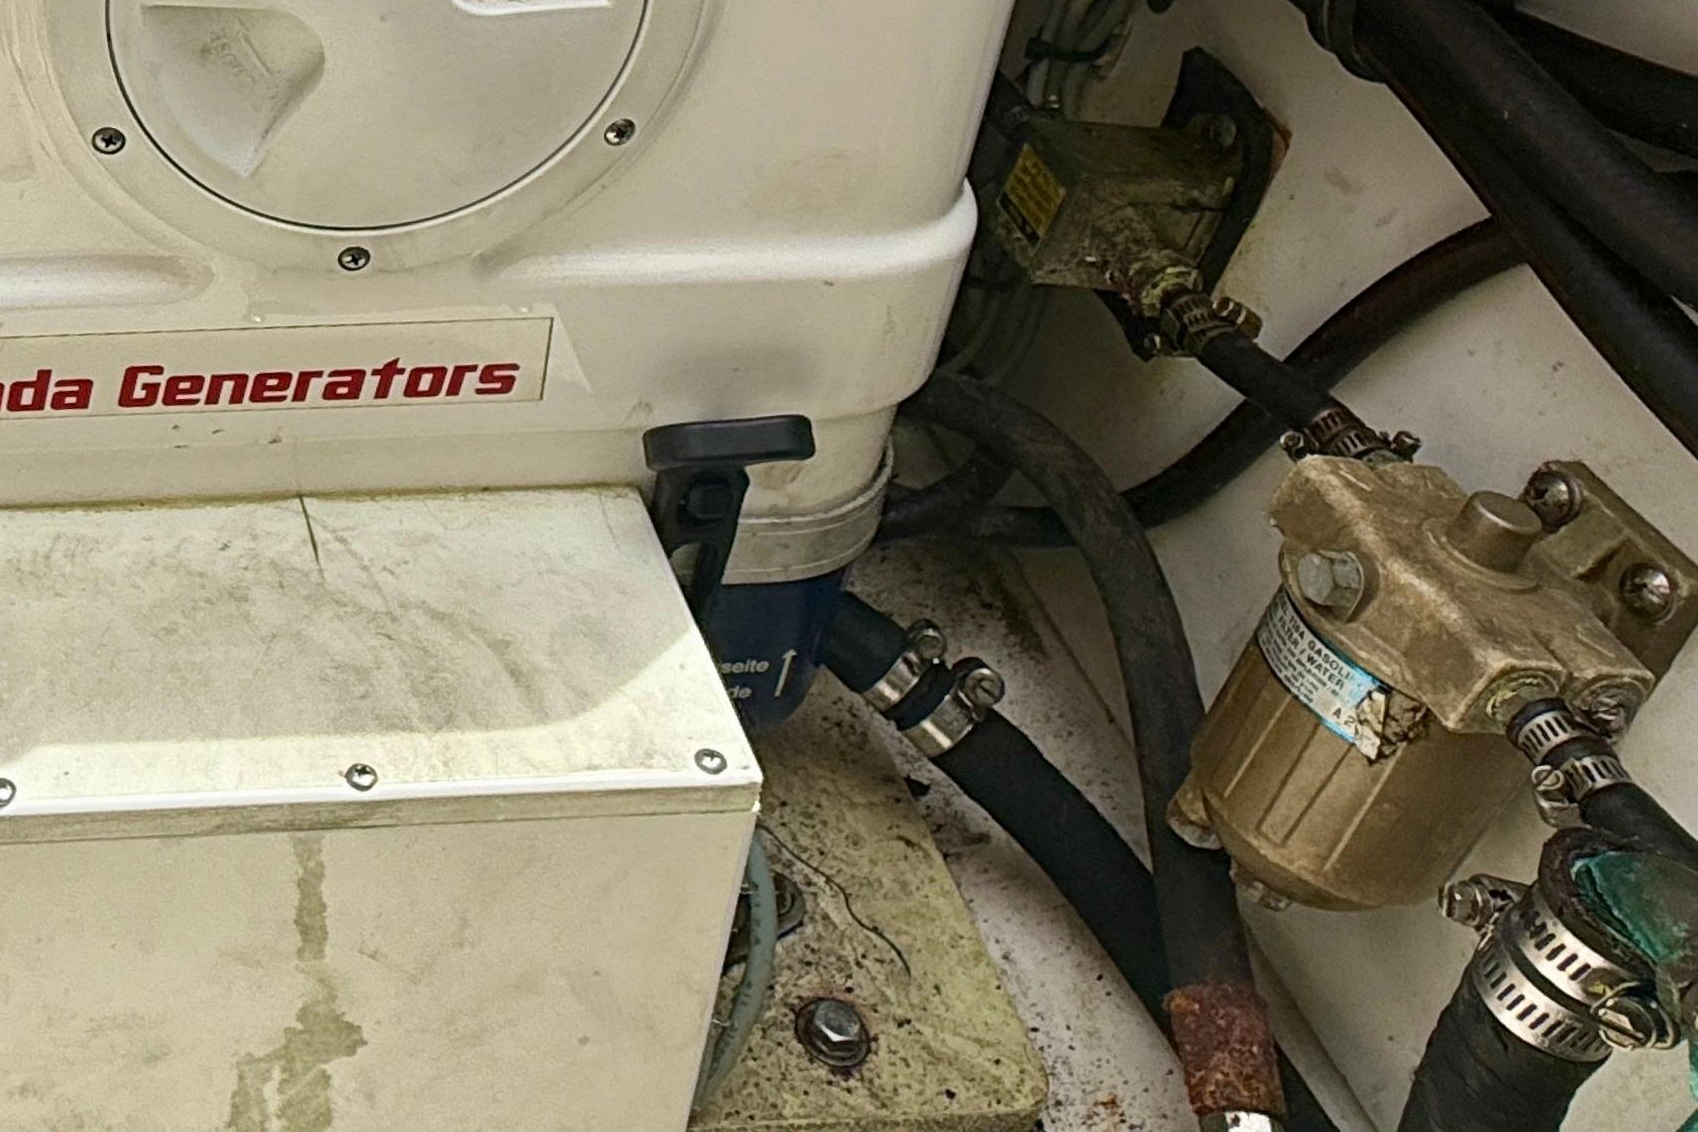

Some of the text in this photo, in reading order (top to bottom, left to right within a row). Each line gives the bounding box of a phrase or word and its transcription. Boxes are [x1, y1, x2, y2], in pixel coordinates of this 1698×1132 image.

[117, 357, 521, 408] Generators
[1307, 640, 1351, 680] GASOLI
[1307, 654, 1345, 689] WATER
